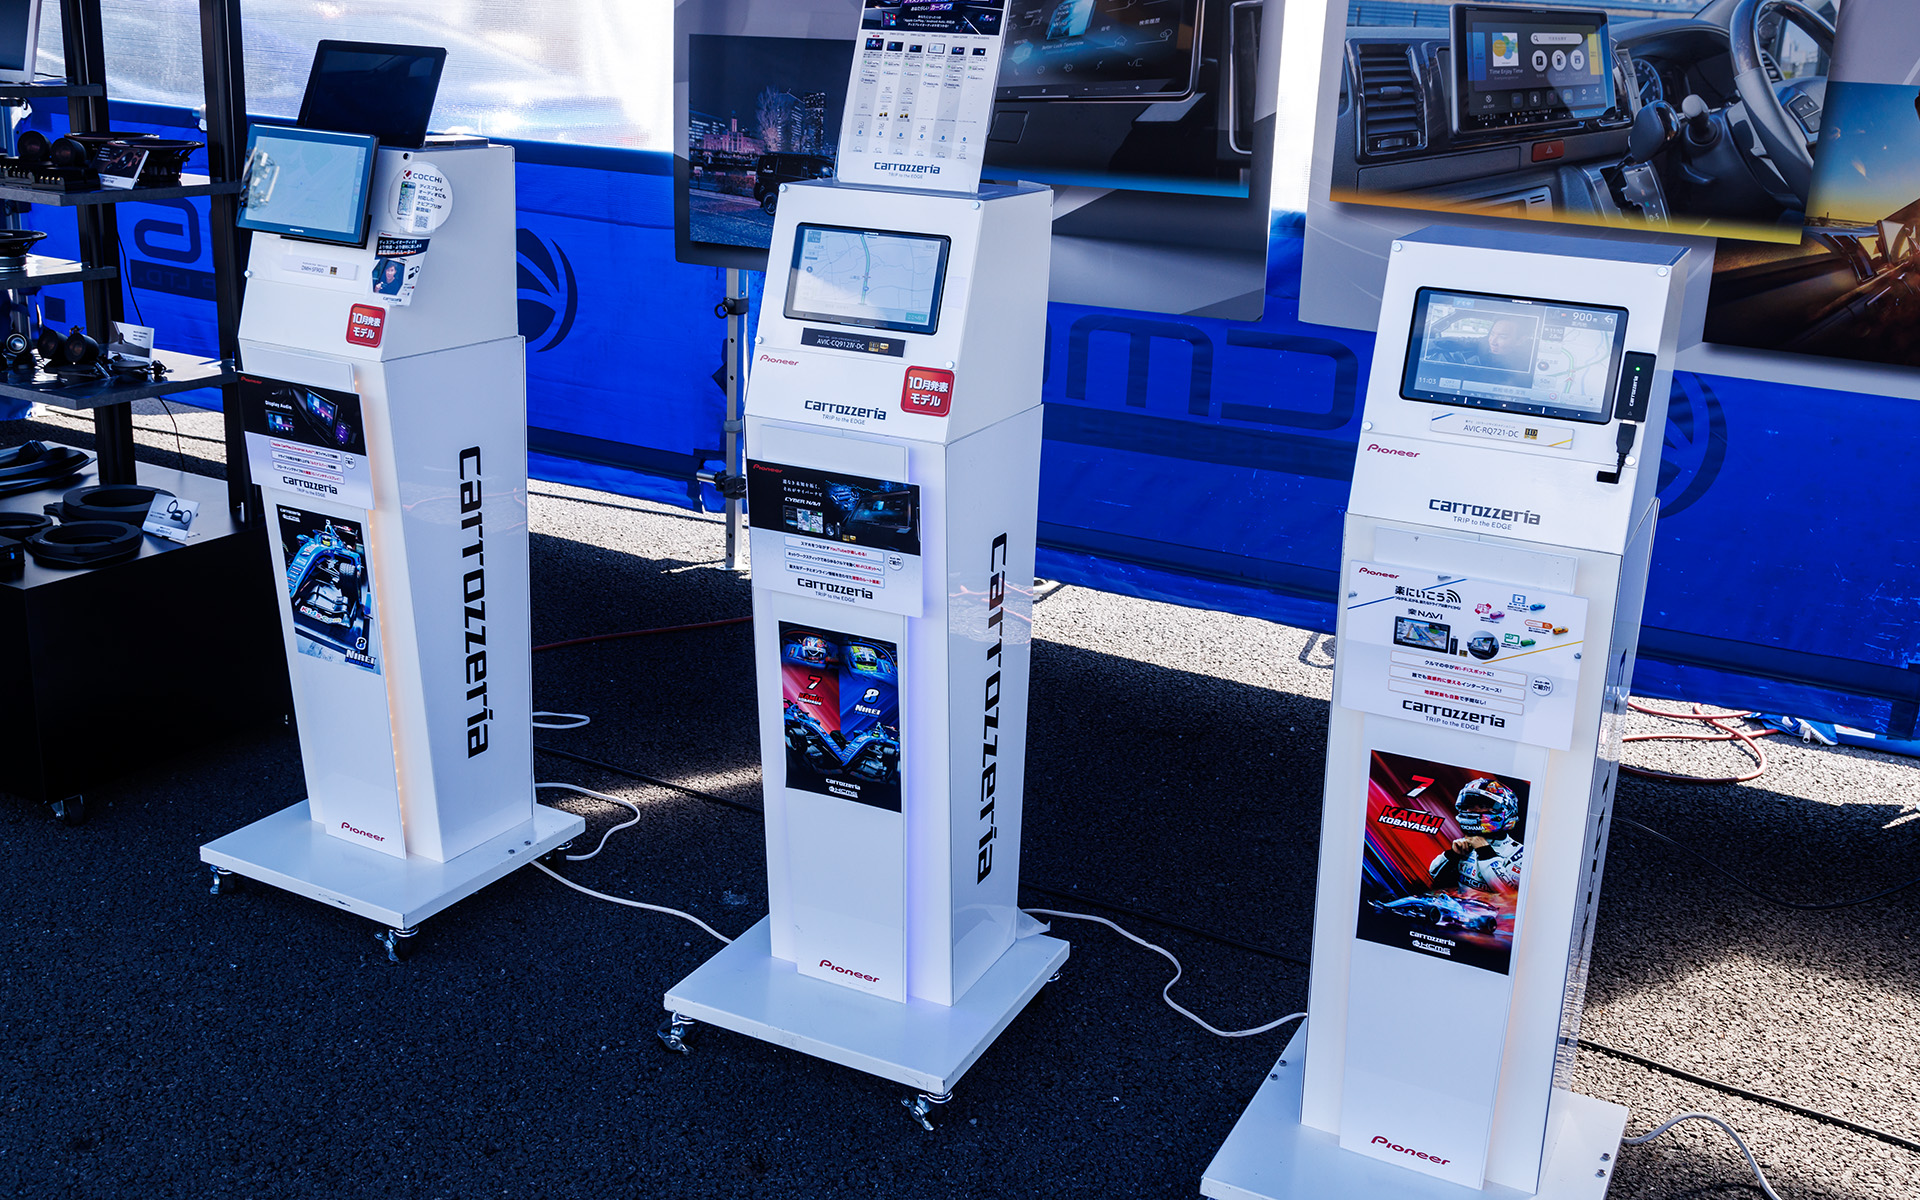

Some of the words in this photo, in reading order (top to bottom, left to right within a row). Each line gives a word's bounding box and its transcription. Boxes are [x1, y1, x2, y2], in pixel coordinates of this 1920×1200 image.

[874, 161, 941, 176] carrozzeria
[352, 312, 381, 327] 10月発表
[353, 326, 375, 339] モデル
[759, 354, 795, 367] Pioneer
[908, 375, 949, 394] 10月発表
[1419, 377, 1436, 385] 11:03
[1629, 375, 1640, 407] carrozzeria
[910, 392, 941, 408] モデル
[804, 399, 888, 421] carrozzeria
[822, 413, 835, 421] TRIP
[850, 417, 866, 425] EDGE
[1463, 424, 1519, 438] AVIC-RQ721-DC
[1367, 443, 1421, 458] Pioneer
[752, 463, 783, 474] Pioneer
[283, 475, 338, 495] carrozzeria
[785, 496, 806, 505] CYBER
[805, 499, 822, 507] NAVI
[1428, 498, 1541, 526] carrozzeria
[1453, 516, 1471, 525] TRIP
[1471, 518, 1479, 526] to
[1479, 518, 1491, 528] the
[1491, 520, 1512, 531] EDGE
[1358, 566, 1400, 580] Pioneer
[797, 577, 874, 600] carrozzeria
[459, 446, 494, 760] carrozzeria
[1408, 608, 1443, 620] 楽NAVI
[355, 637, 367, 650] 8
[346, 650, 375, 665] NIREI
[1424, 660, 1494, 678] クルマの中がWi-Fiスポットに!
[806, 676, 823, 690] 7
[1411, 672, 1502, 694] 誰でも直感的に使えるインターフェース!
[1532, 683, 1551, 692] ご紹介!
[863, 688, 880, 704] 8
[855, 704, 881, 716] NIREI
[977, 532, 1008, 886] carrozzeria
[1402, 699, 1506, 729] carrozzeria
[1426, 715, 1441, 723] TRIP
[1449, 719, 1460, 728] the
[1461, 722, 1480, 731] EDGE
[825, 778, 861, 791] carrozzeria
[1407, 775, 1435, 798] 7
[1379, 815, 1438, 834] KOBAYASHI
[1381, 806, 1443, 829] KAMUI
[341, 821, 386, 842] Pioneer
[1409, 930, 1456, 947] carrozzeria
[819, 959, 880, 983] Pioneer
[1370, 1135, 1451, 1165] Pioneer
